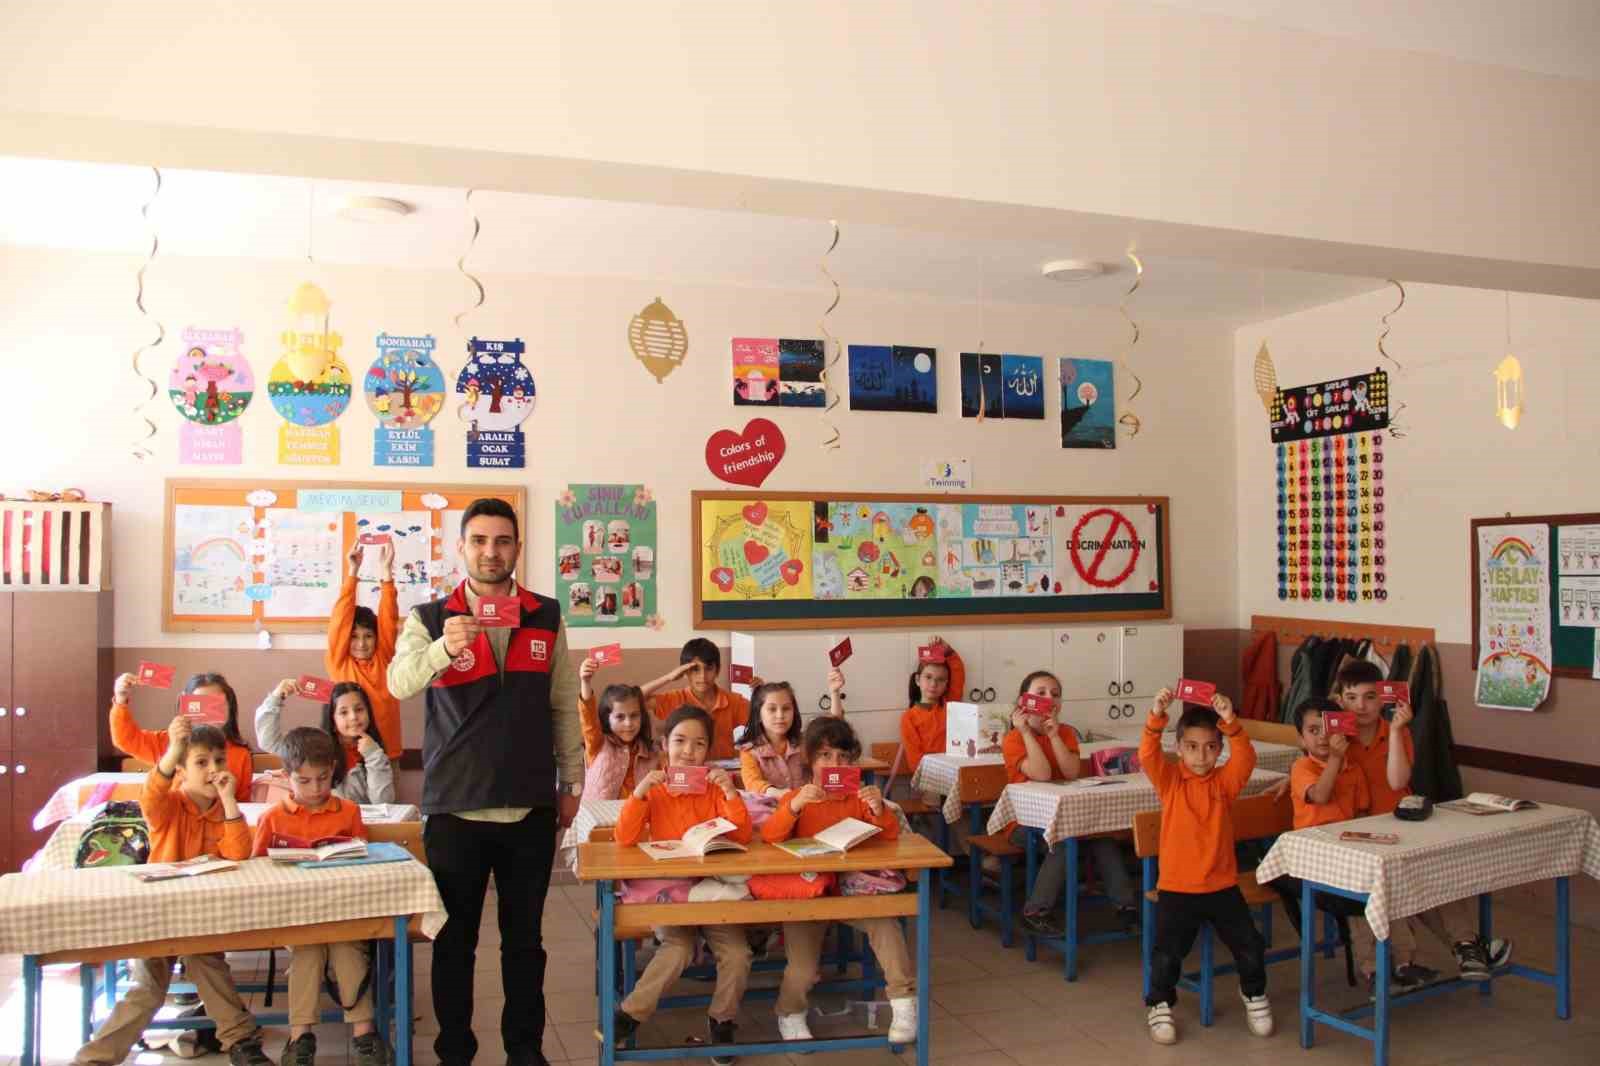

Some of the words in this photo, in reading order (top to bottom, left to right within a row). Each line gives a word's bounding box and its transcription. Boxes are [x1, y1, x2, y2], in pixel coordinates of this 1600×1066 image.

[478, 433, 515, 441] ARALIK
[1372, 435, 1382, 445] 10
[481, 445, 509, 453] OCAK
[719, 442, 752, 457] Colors
[755, 435, 766, 447] of
[723, 450, 776, 475] friendship
[1373, 469, 1384, 480] 30
[1360, 487, 1369, 497] 36
[1373, 486, 1384, 497] 40
[1373, 503, 1384, 514] 50
[1066, 539, 1146, 551] DCRIMNATIN
[1374, 555, 1385, 566] 80
[1374, 572, 1385, 583] 90
[1362, 589, 1372, 601] 90
[1374, 588, 1388, 600] 100
